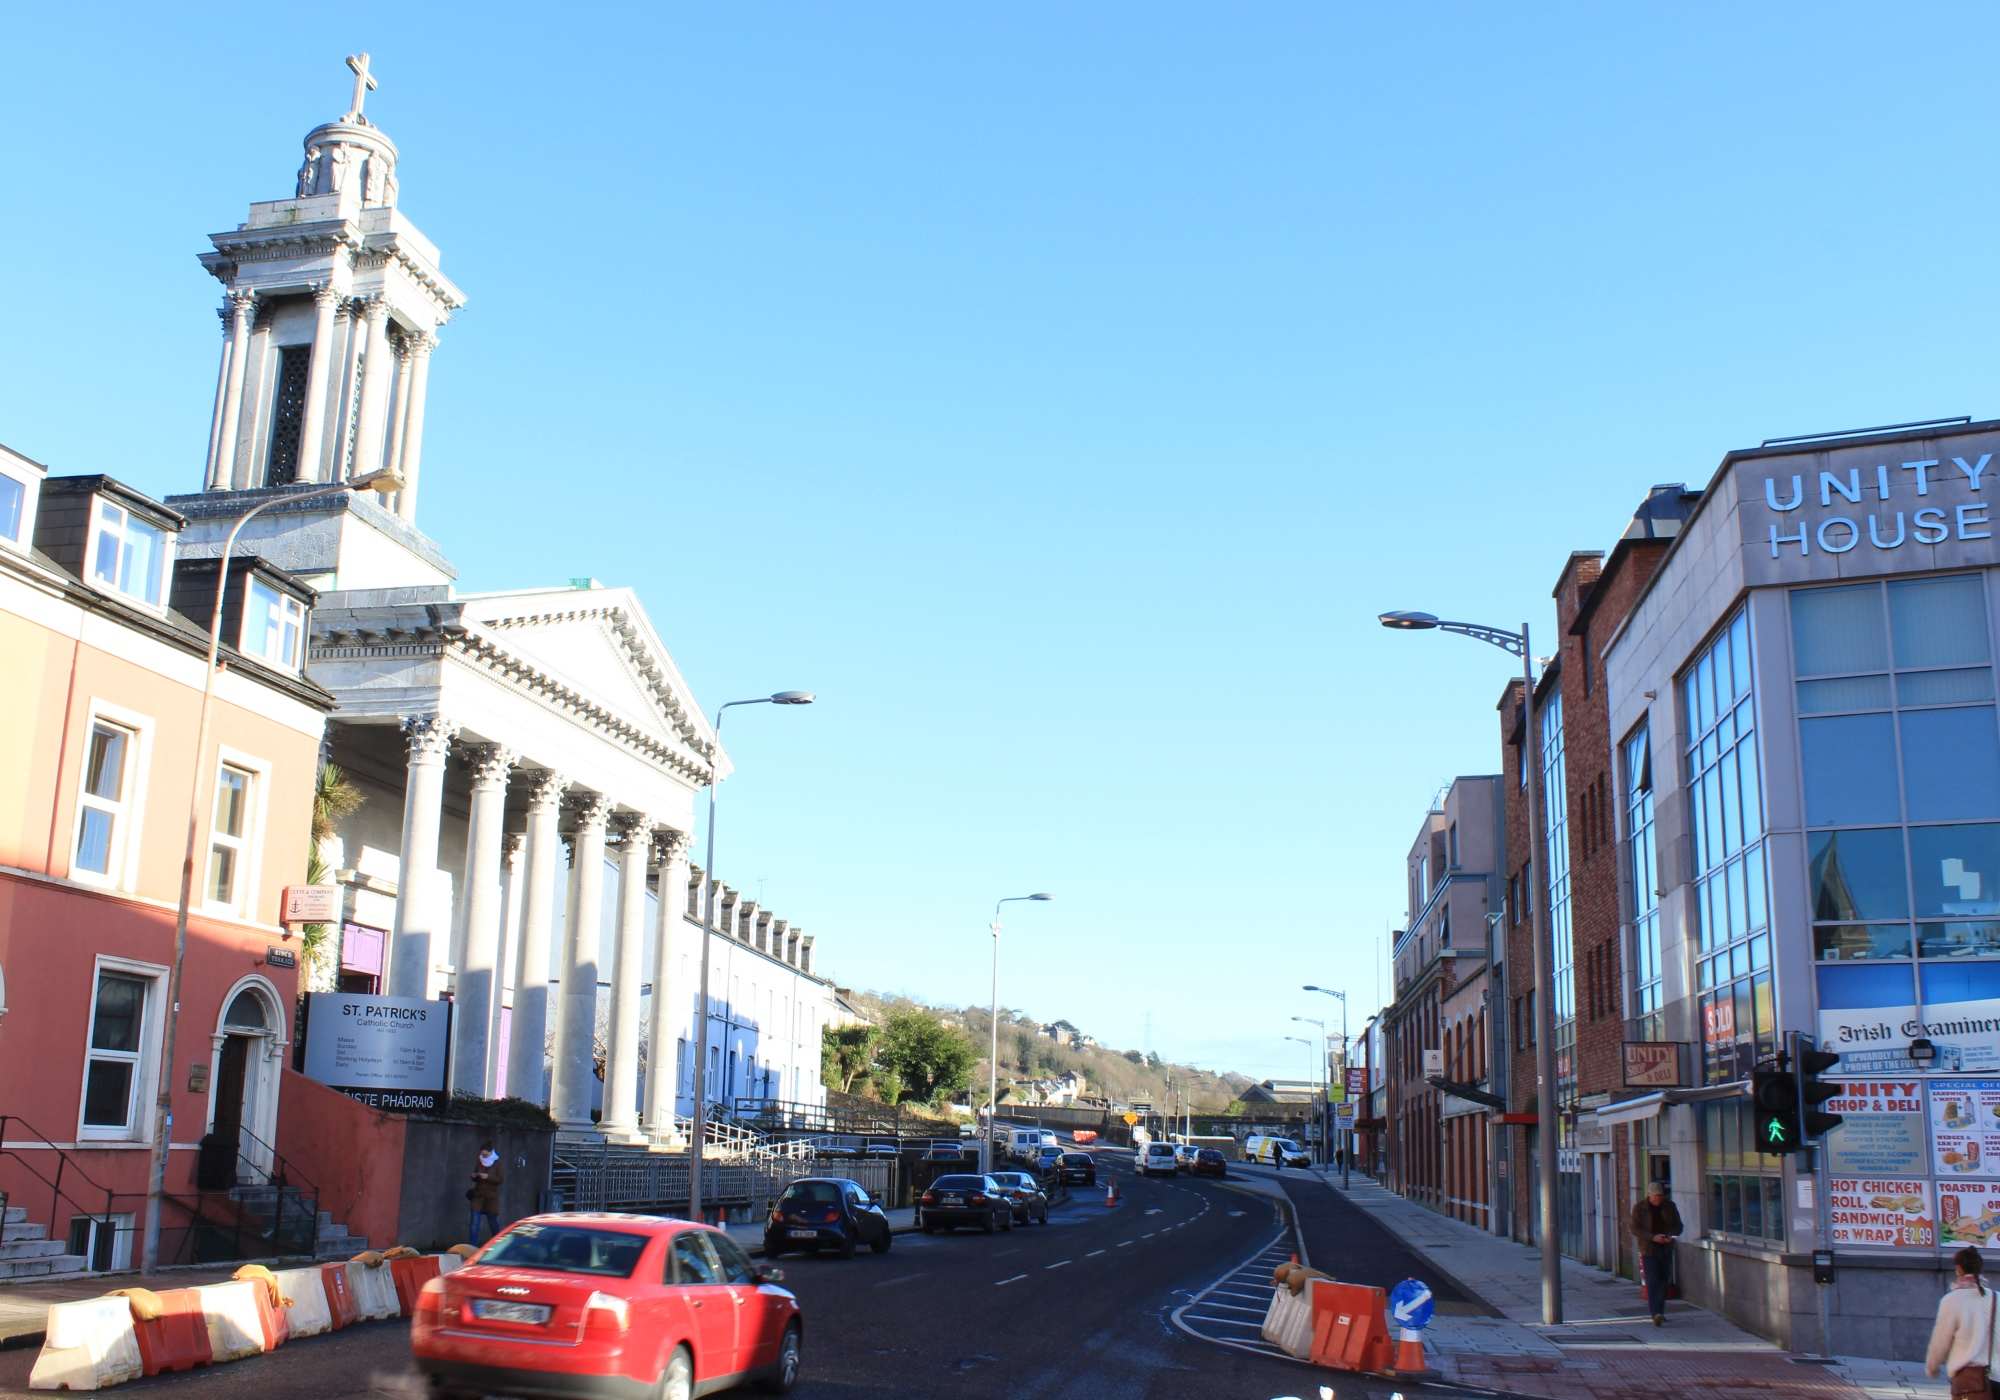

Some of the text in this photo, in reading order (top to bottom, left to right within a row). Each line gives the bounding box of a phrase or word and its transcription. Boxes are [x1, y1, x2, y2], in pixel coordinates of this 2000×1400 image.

[1764, 453, 1993, 512] UNITY
[1769, 503, 1992, 559] HOUSE
[343, 1004, 427, 1021] ST. PATRICK'S
[356, 1018, 415, 1030] Catholic Church
[1838, 1022, 1892, 1043] Irish
[1626, 1047, 1674, 1062] UNITY
[381, 1091, 434, 1109] PHÁDRAIG
[1828, 1099, 1921, 1112] SHOP & DELI
[1830, 1180, 1923, 1194] HOT CHICKEN
[1939, 1183, 1986, 1193] TOASTED
[1831, 1211, 1905, 1226] SANDWICH
[1832, 1228, 1894, 1241] OR WRAP
